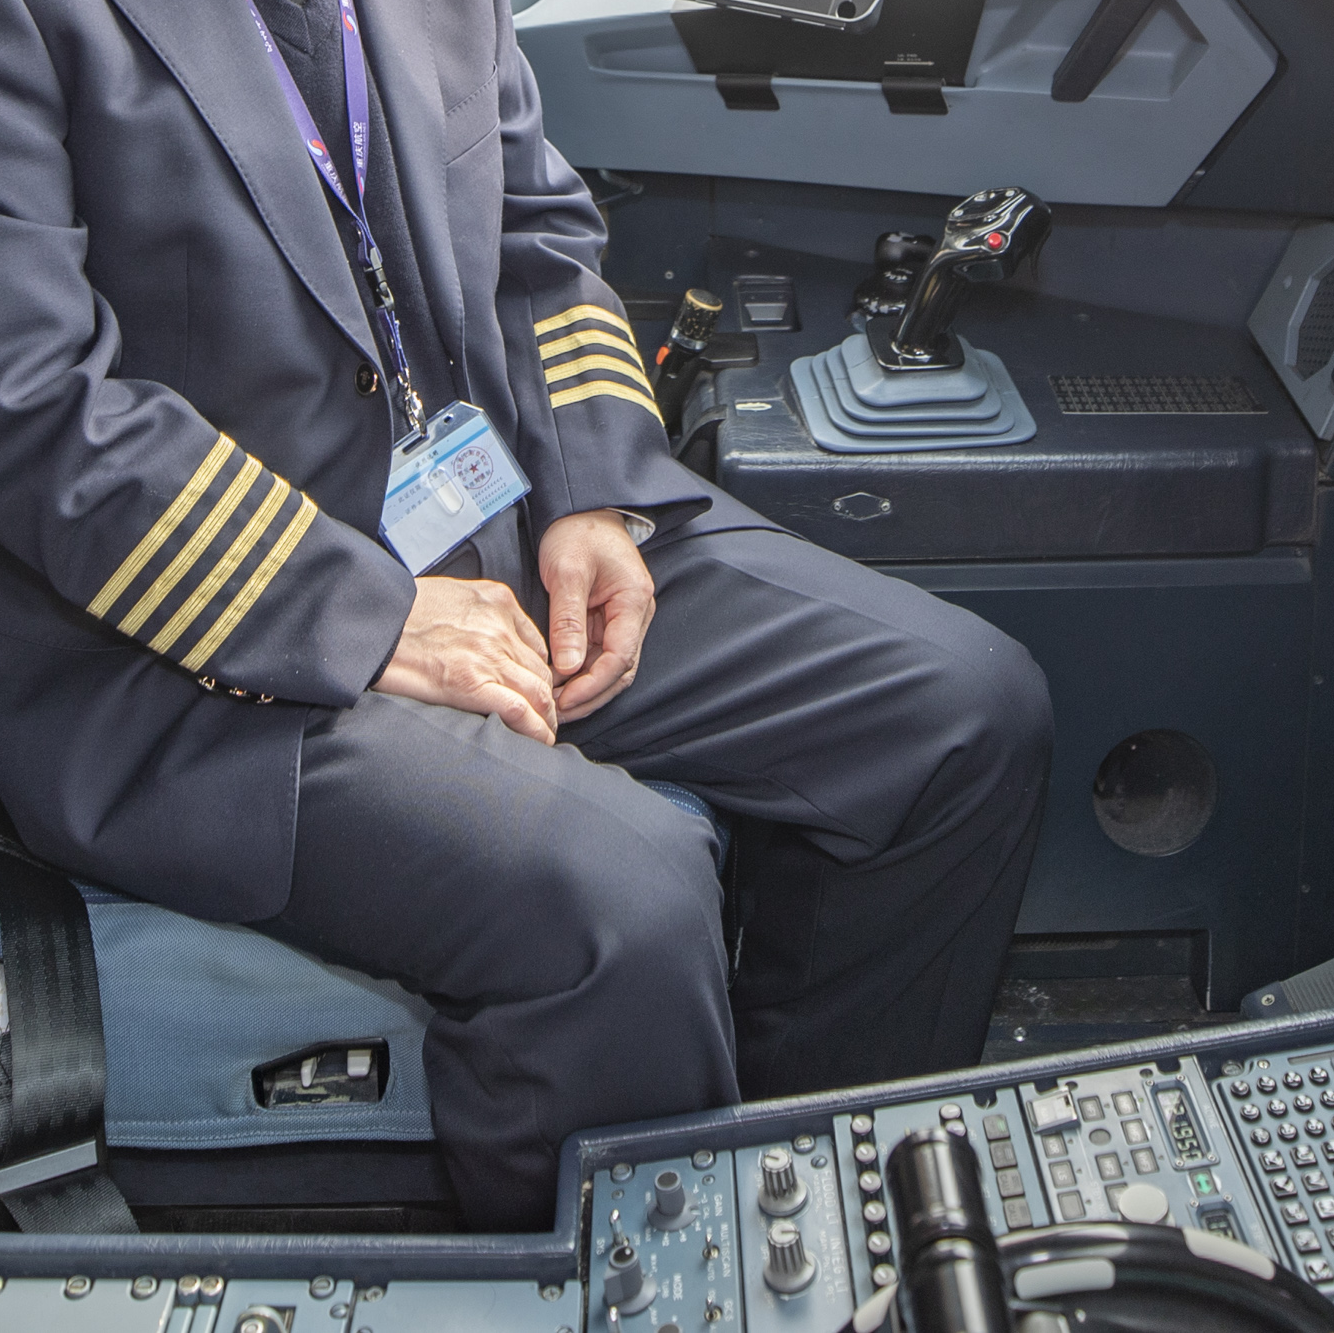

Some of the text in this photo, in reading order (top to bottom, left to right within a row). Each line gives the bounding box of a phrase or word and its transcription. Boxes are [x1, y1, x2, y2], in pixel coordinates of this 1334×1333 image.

[352, 121, 365, 169] 重庆航空
[1084, 1102, 1097, 1118] HF1
[1045, 1137, 1060, 1155] VOR
[1056, 1168, 1068, 1182] LS
[1102, 1159, 1116, 1177] HF2
[714, 1194, 723, 1217] GAIN
[821, 1170, 839, 1225] FLOOD LT
[720, 1223, 733, 1278] MULTISCAN
[830, 1237, 848, 1293] INTEG LT
[673, 1273, 684, 1301] MODE
[723, 1299, 734, 1322] GCS
